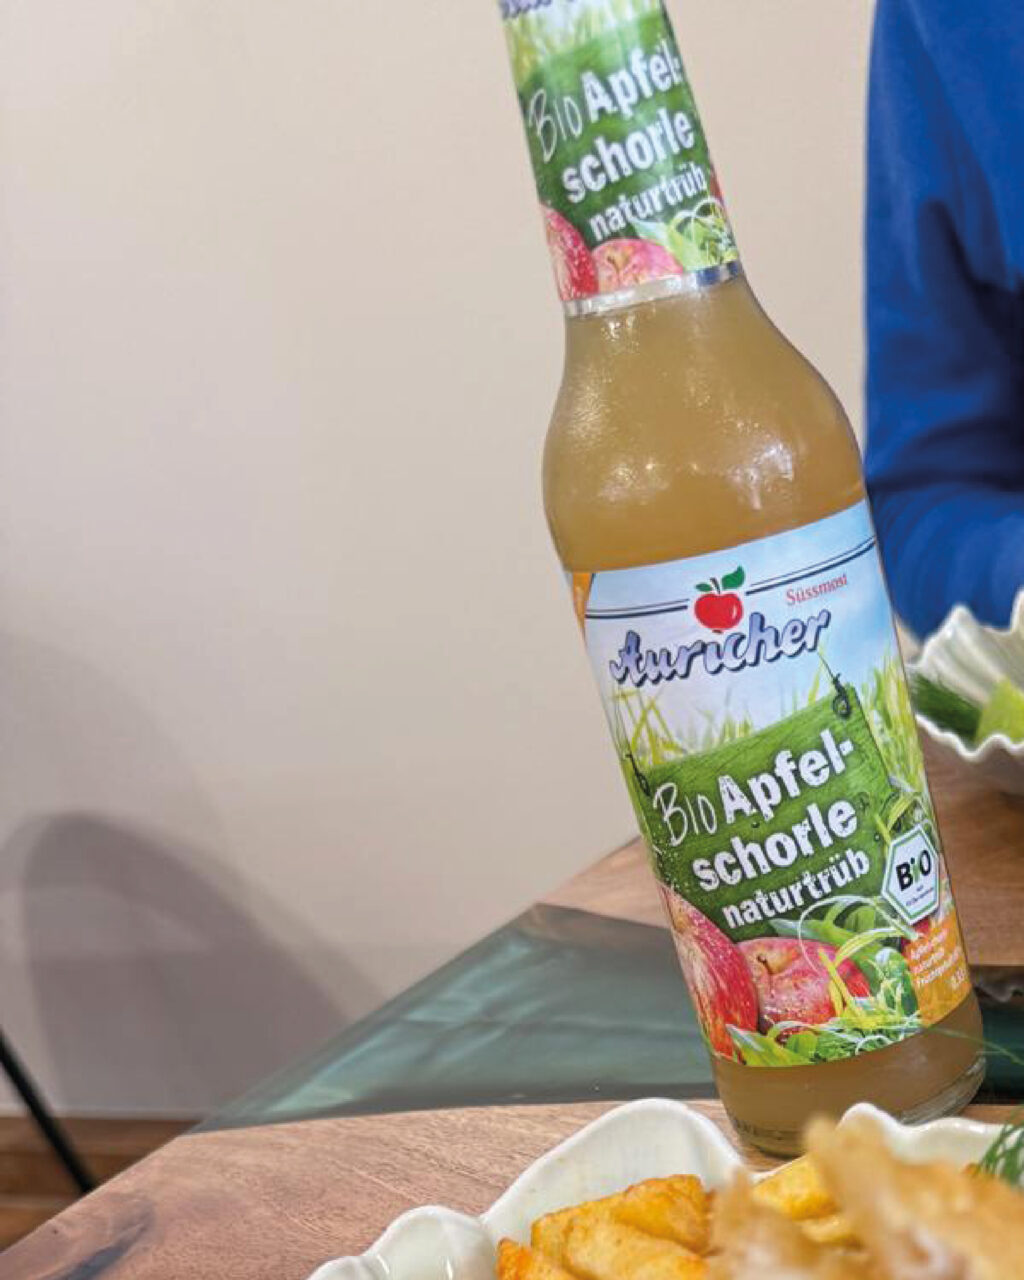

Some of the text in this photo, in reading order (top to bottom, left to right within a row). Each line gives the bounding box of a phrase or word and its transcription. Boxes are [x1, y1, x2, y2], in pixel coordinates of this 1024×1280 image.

[562, 108, 695, 203] schorle
[589, 161, 707, 241] naturtrüb
[785, 573, 848, 606] Süssmost
[609, 609, 832, 687] Auricher
[718, 729, 854, 823] Apfel-
[692, 799, 858, 892] schorle
[722, 849, 871, 929] naturtrüb
